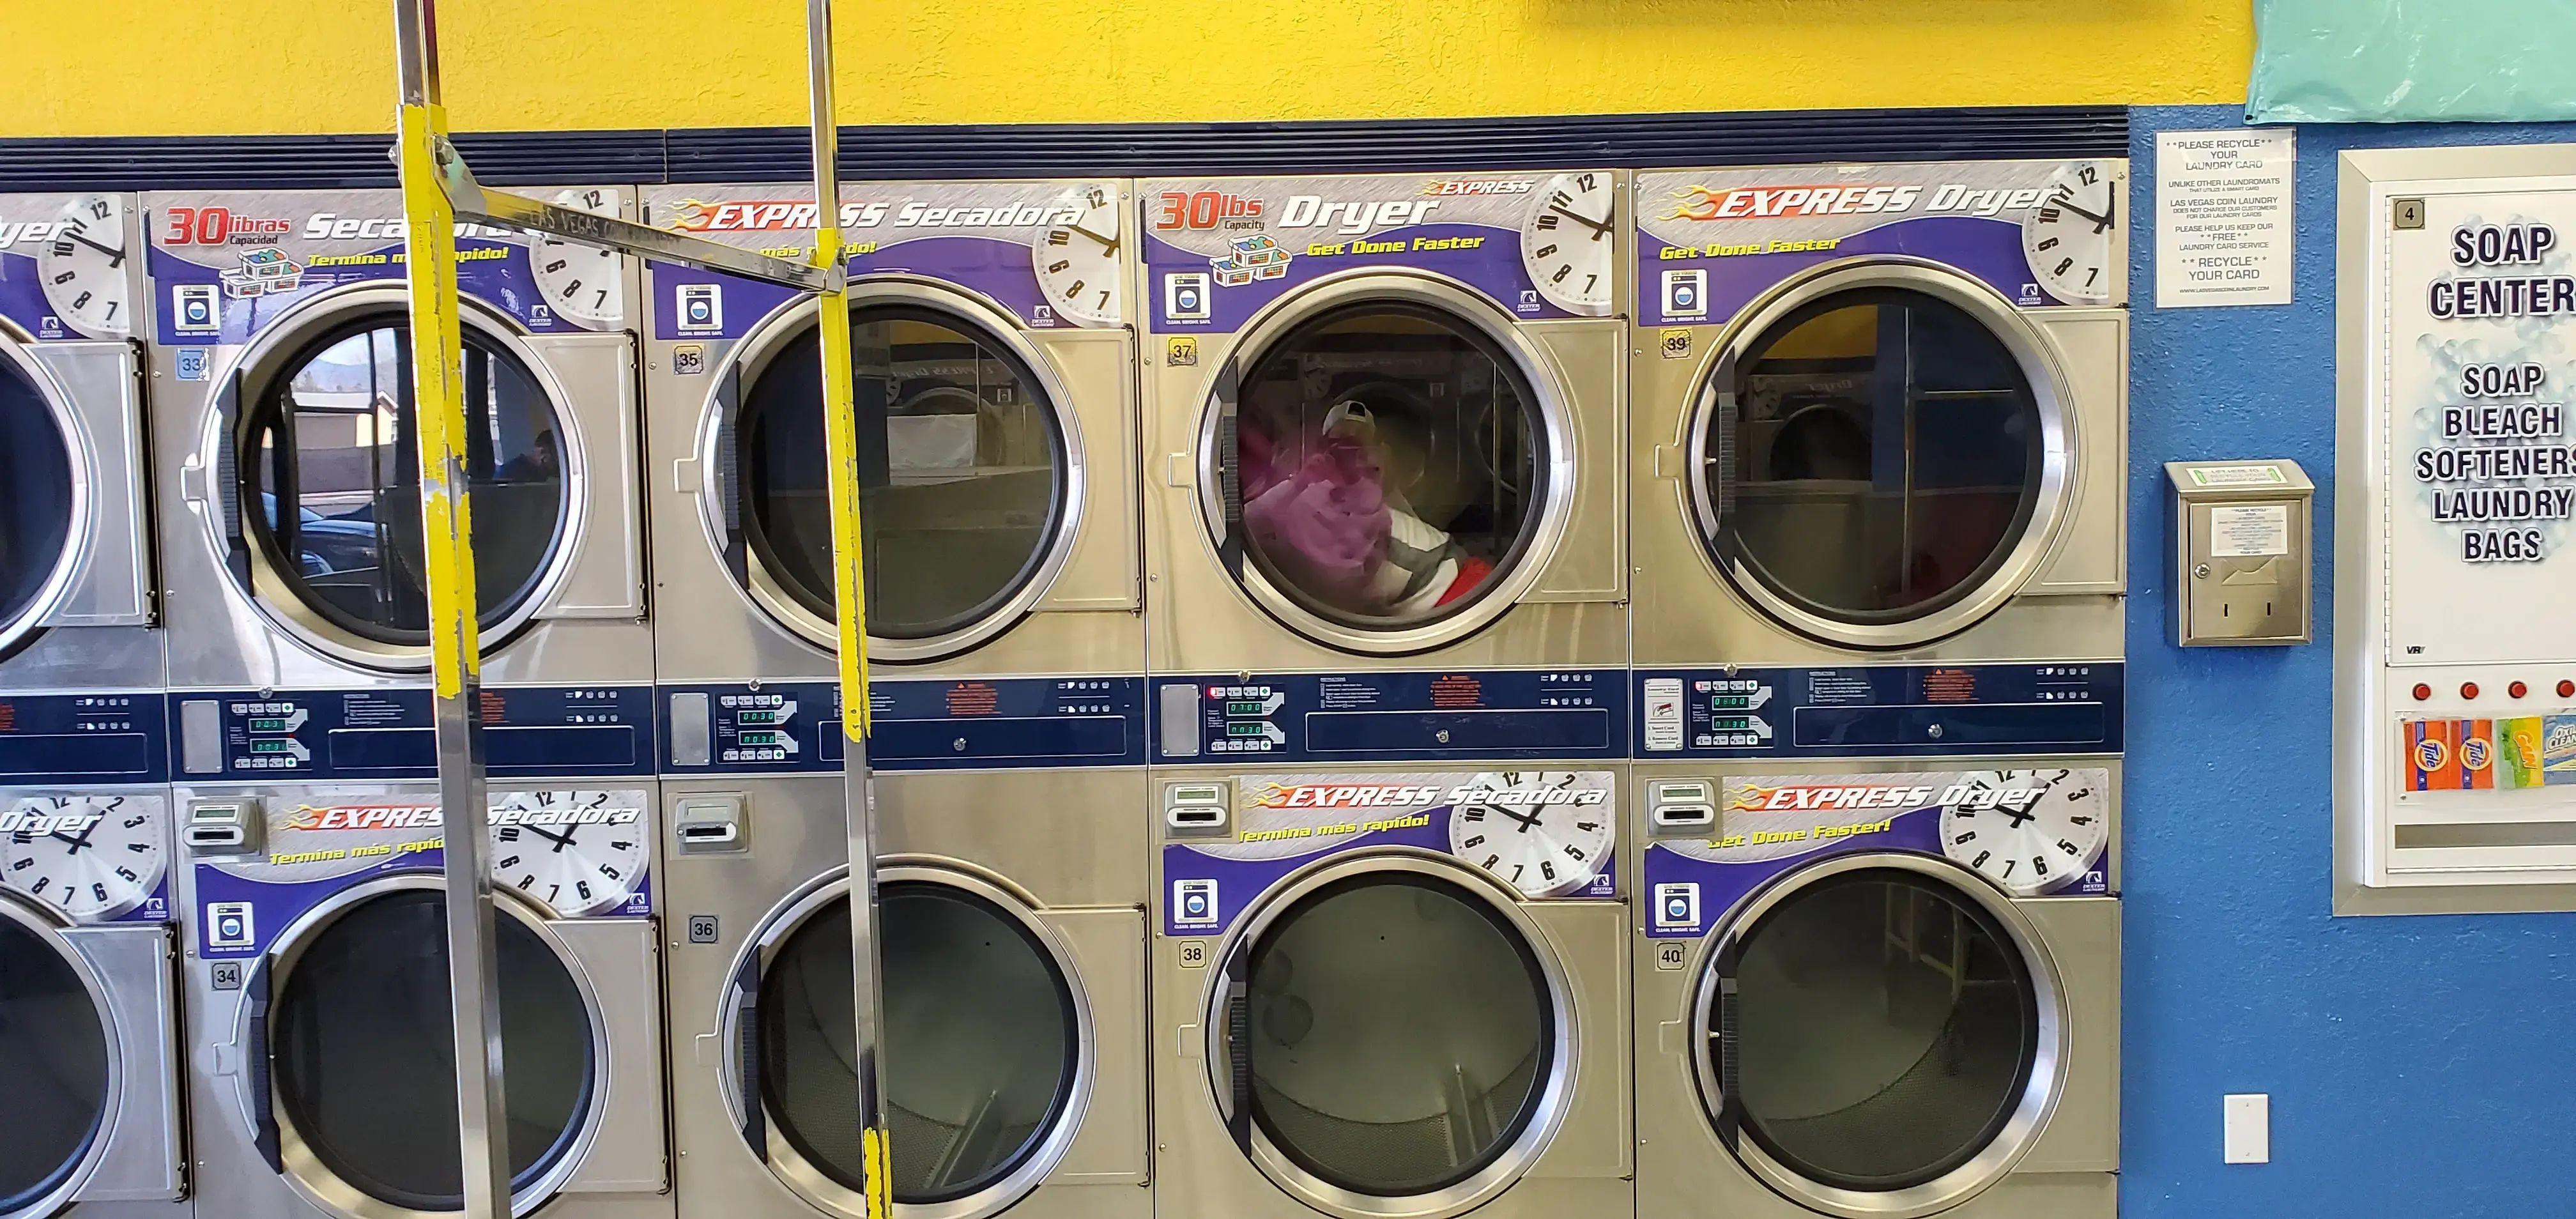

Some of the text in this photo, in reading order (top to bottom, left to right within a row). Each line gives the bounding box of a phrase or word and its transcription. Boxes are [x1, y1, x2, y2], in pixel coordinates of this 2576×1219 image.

[2211, 151, 2237, 159] YOUR
[2186, 160, 2263, 171] LAUNDRY CARD
[1576, 173, 1597, 194] 12
[2078, 166, 2099, 187] 12
[1439, 180, 1534, 195] EXPRESS
[1086, 189, 1107, 210] 12
[1552, 190, 1574, 208] 11
[1715, 184, 2063, 218] EXPRESS Dryer
[708, 202, 1086, 229] EXPRSS Secadora
[1156, 190, 1264, 231] 30 lbs
[1278, 195, 1441, 235] Dryer
[2038, 208, 2060, 224] 10
[2405, 208, 2414, 220] 4
[163, 206, 290, 245] 30 libras
[560, 208, 599, 237] VEGAS
[1225, 220, 1265, 231] Capacity
[1537, 215, 1559, 231] 10
[230, 235, 278, 247] Capacidad
[1048, 230, 1070, 246] 10
[1307, 236, 1485, 256] Get Done Faster
[2038, 237, 2059, 251] 9
[2453, 227, 2553, 264] SOAP
[1536, 243, 1558, 258] 9
[1660, 239, 1841, 260] Get Done Faster
[308, 253, 387, 266] Termina
[1049, 259, 1070, 274] 9
[2054, 257, 2073, 276] 8
[1552, 264, 1572, 283] 8
[2085, 268, 2099, 288] 7
[2188, 269, 2260, 280] YOUR CARD
[1065, 280, 1085, 299] 8
[1584, 274, 1597, 294] 7
[1097, 291, 1110, 310] 7
[2430, 278, 2576, 316] CENTER
[1173, 345, 1192, 358] 37
[1667, 337, 1686, 350] 39
[182, 358, 199, 371] 33
[679, 353, 698, 366] 35
[2463, 365, 2542, 395] SOAP
[2444, 406, 2560, 436] BLEACH
[2417, 448, 2576, 479] SOFTENER
[2434, 489, 2572, 519] LAUNDRY
[2464, 531, 2541, 560] BAGS
[2420, 742, 2439, 768] Tide
[2465, 741, 2483, 767] Tide
[1503, 772, 1523, 788] 12
[1286, 785, 1607, 808] EXPRESS Secadora
[1765, 785, 2047, 810] EXPRESS Dryer
[2067, 788, 2089, 802] 3
[0, 811, 102, 836] Dryer
[319, 806, 443, 829] EXPRES
[1464, 808, 1486, 822] 10
[2070, 816, 2092, 826] 4
[1317, 822, 1356, 836] más
[1363, 814, 1430, 832] rapido!
[1577, 822, 1598, 832] 4
[1752, 830, 1805, 845] Done
[1814, 818, 1891, 839] Faster!
[1464, 835, 1485, 848] 9
[1955, 831, 1976, 845] 9
[2057, 838, 2078, 855] 5
[270, 848, 346, 866] Termina
[351, 843, 391, 858] más
[1564, 844, 1584, 861] 5
[1972, 850, 1991, 868] 8
[1511, 864, 1524, 883] 7
[1540, 861, 1555, 880] 6
[2002, 860, 2016, 878] 7
[2032, 855, 2048, 876] 6
[694, 923, 712, 936] 36
[1183, 949, 1202, 961] 38
[1661, 950, 1681, 963] 40
[217, 970, 236, 983] 34
